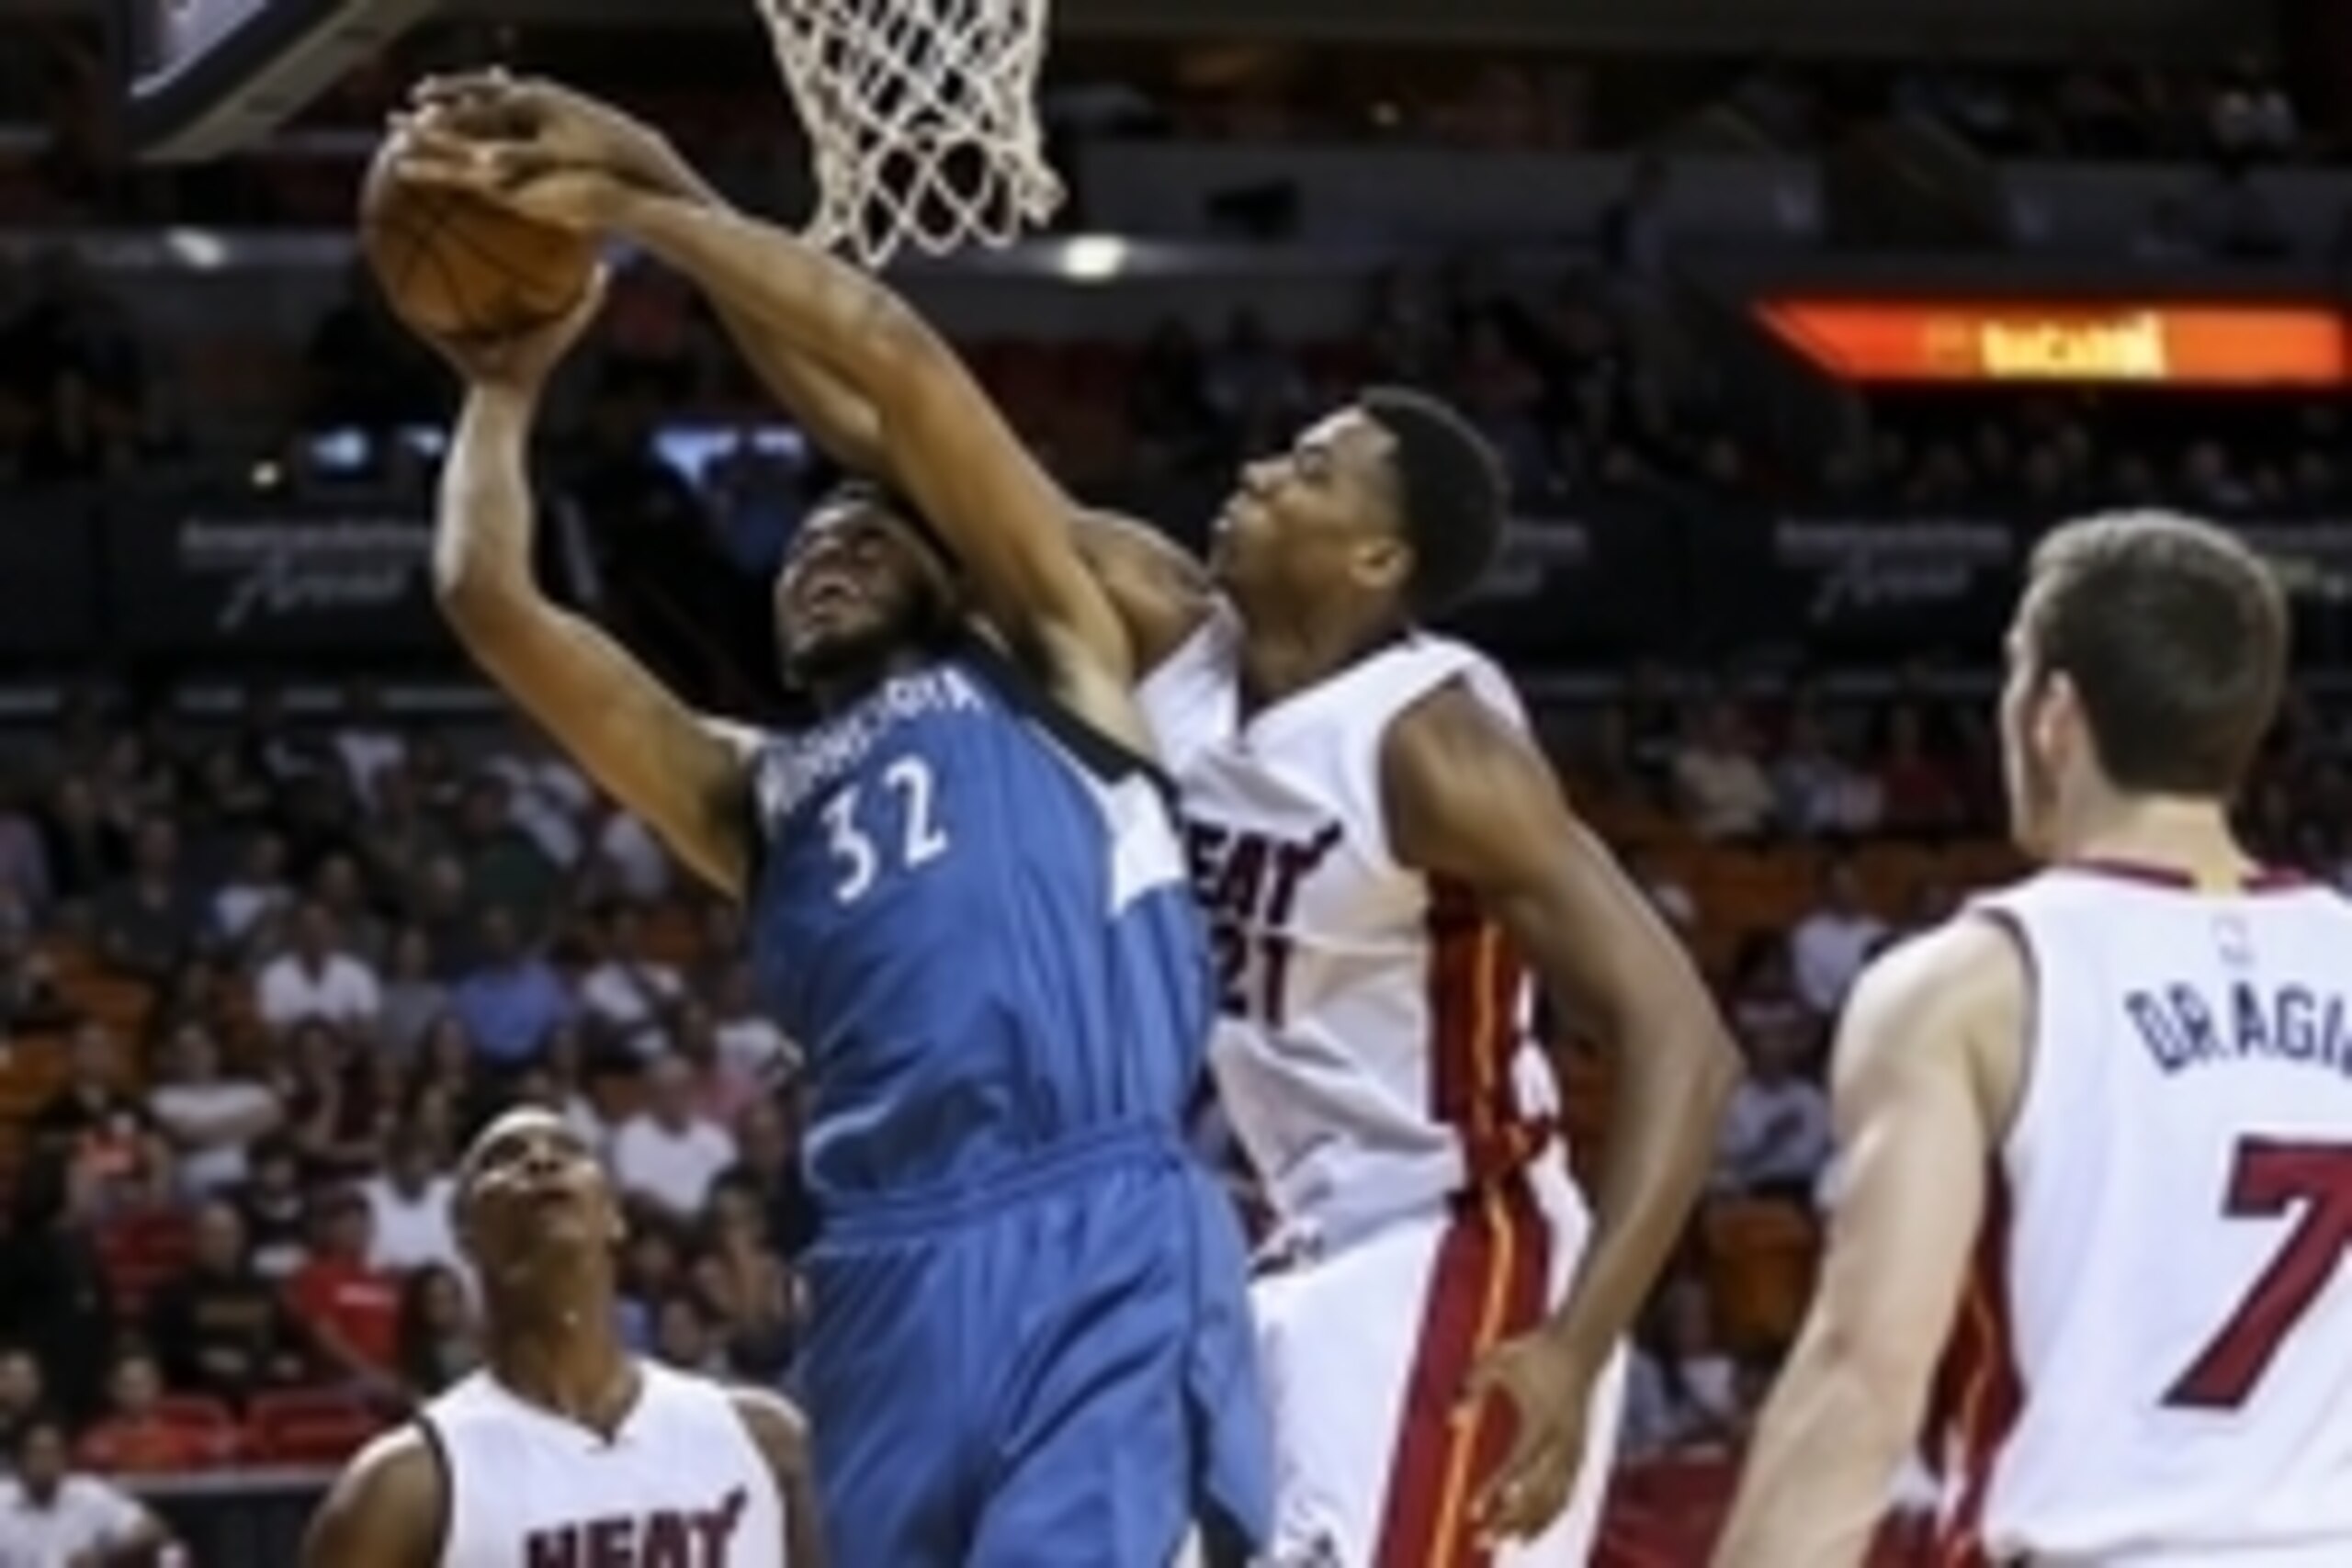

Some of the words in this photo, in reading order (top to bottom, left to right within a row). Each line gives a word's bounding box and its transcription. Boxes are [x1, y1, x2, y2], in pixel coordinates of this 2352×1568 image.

[820, 753, 948, 904] 32
[1188, 820, 1341, 927] EAT
[1207, 927, 1292, 1030] 21
[2157, 1132, 2352, 1407] 7
[526, 1484, 746, 1568] HEAT
